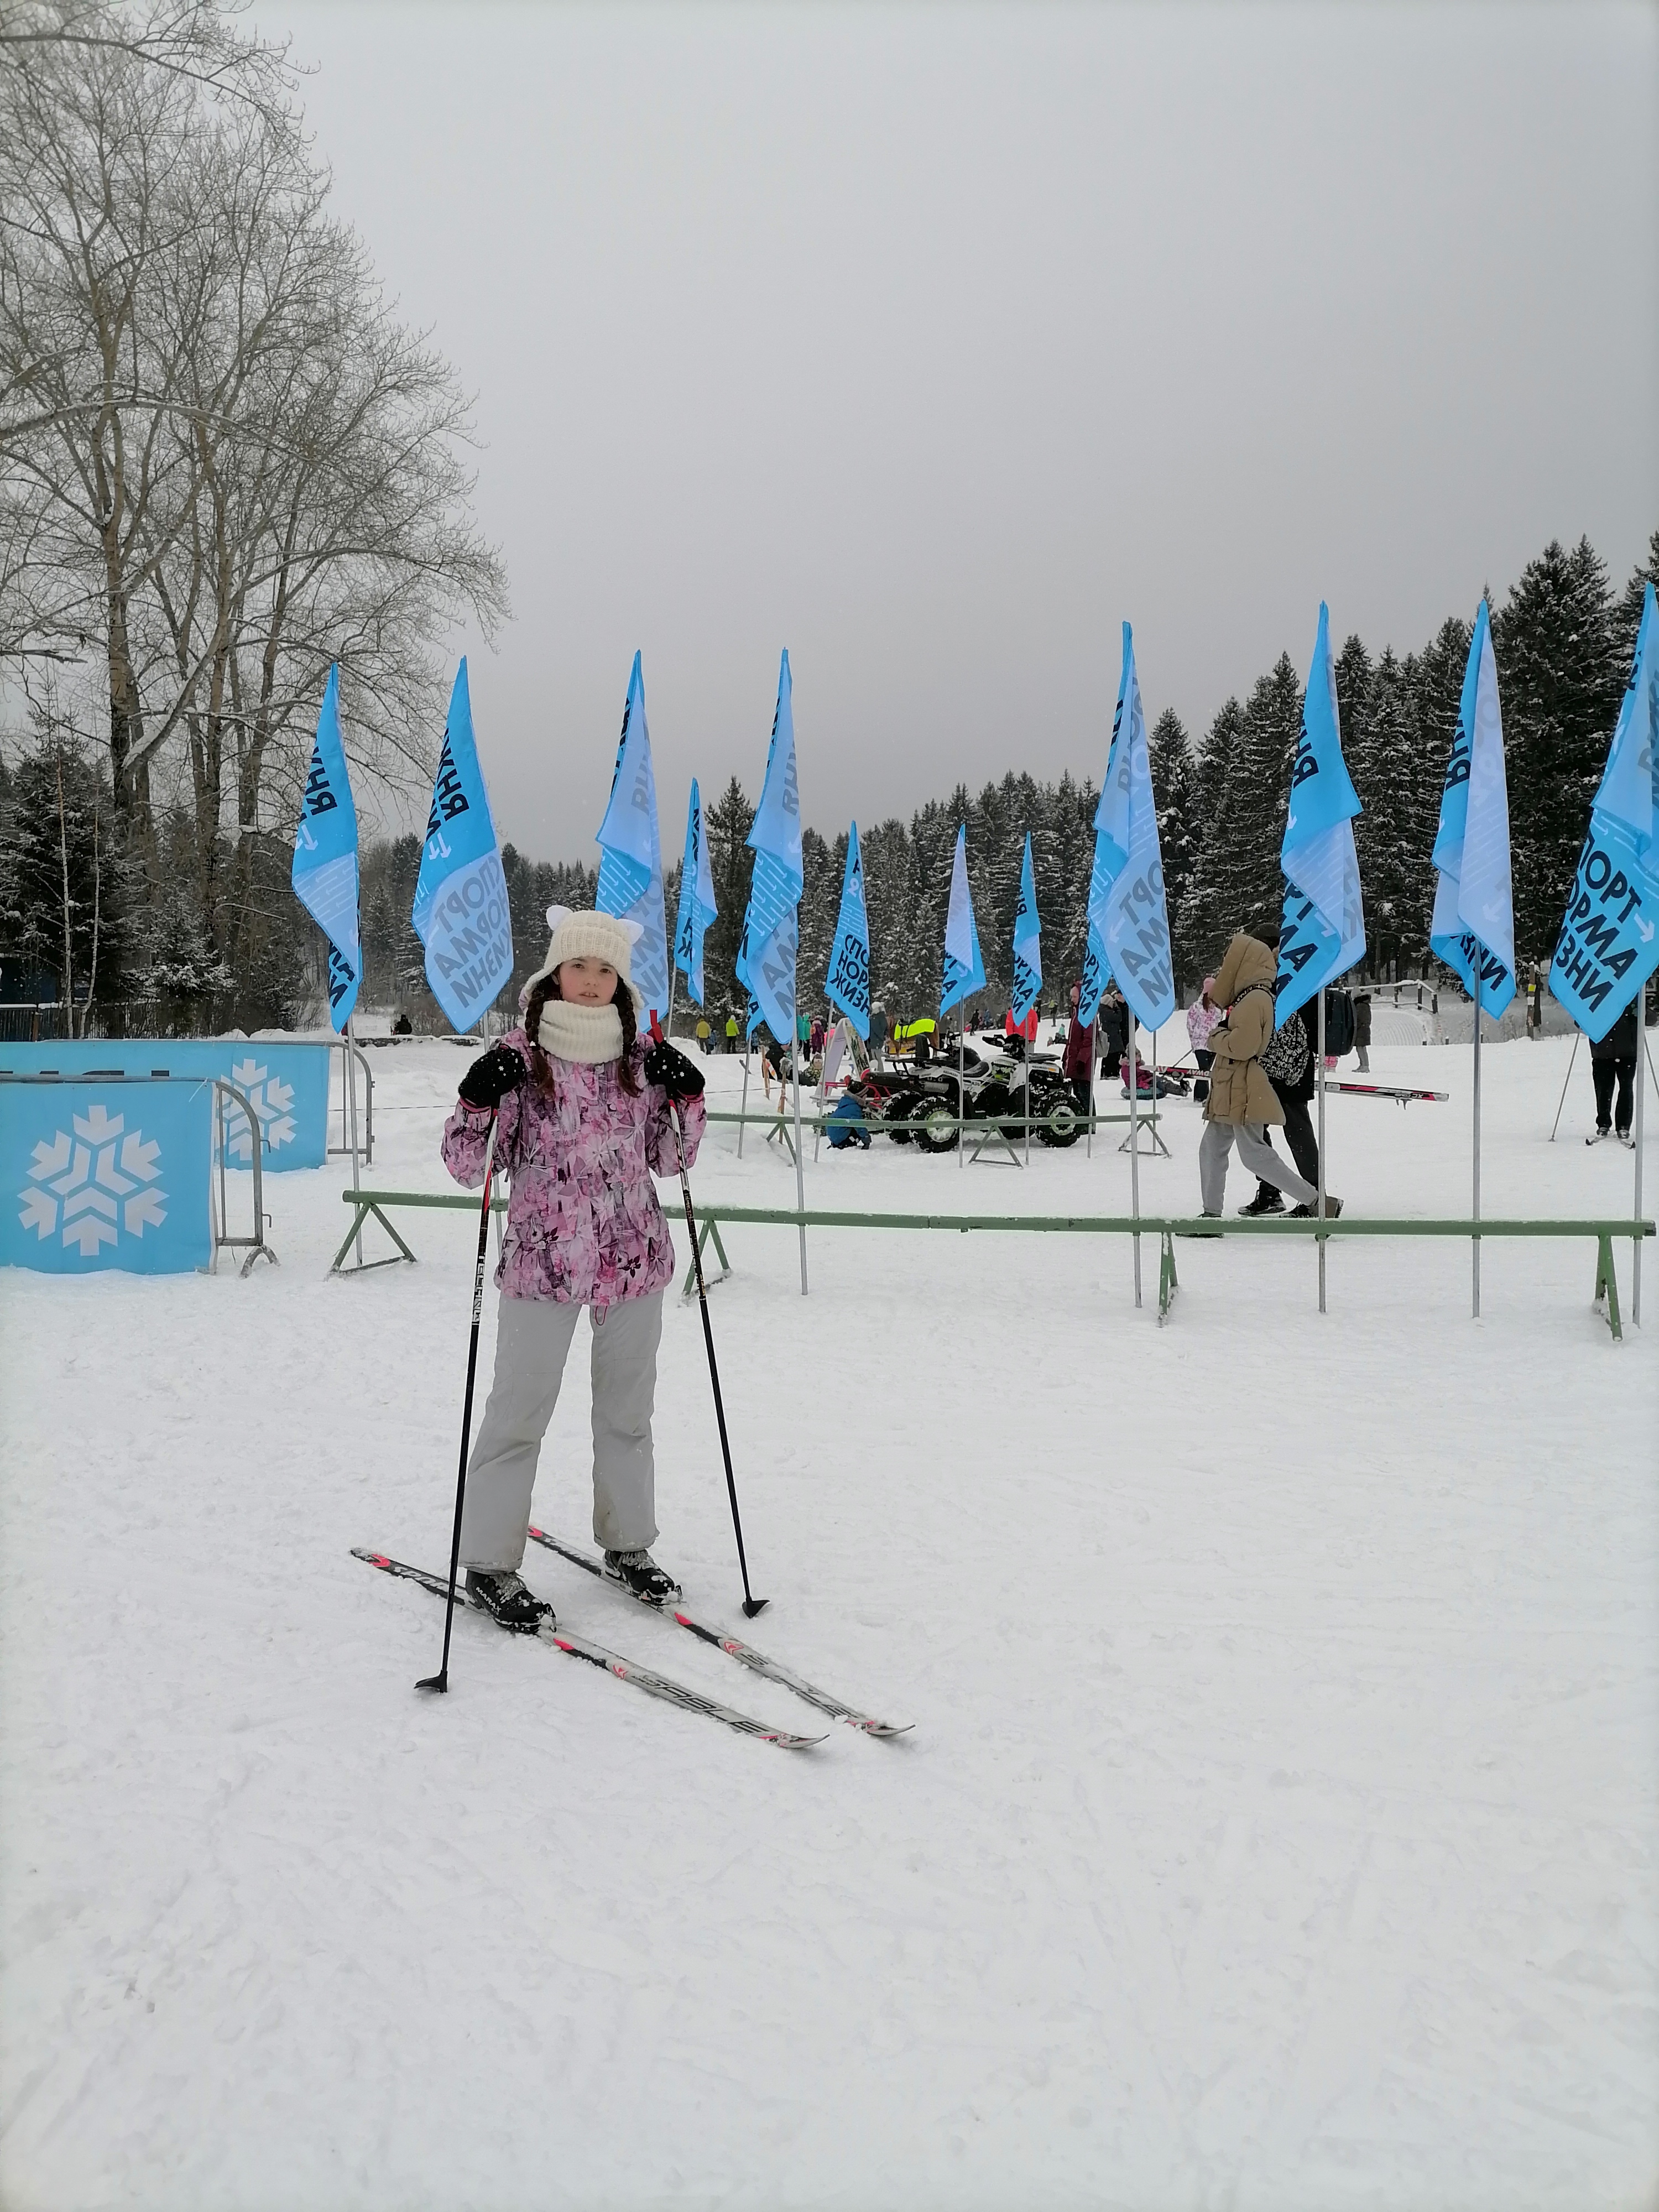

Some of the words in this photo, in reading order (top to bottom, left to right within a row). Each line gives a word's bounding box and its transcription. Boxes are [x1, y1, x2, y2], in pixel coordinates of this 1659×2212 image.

[393, 1566, 450, 1591] SPOR
[476, 1586, 502, 1611] MARAX
[644, 1674, 771, 1733] SABLE
